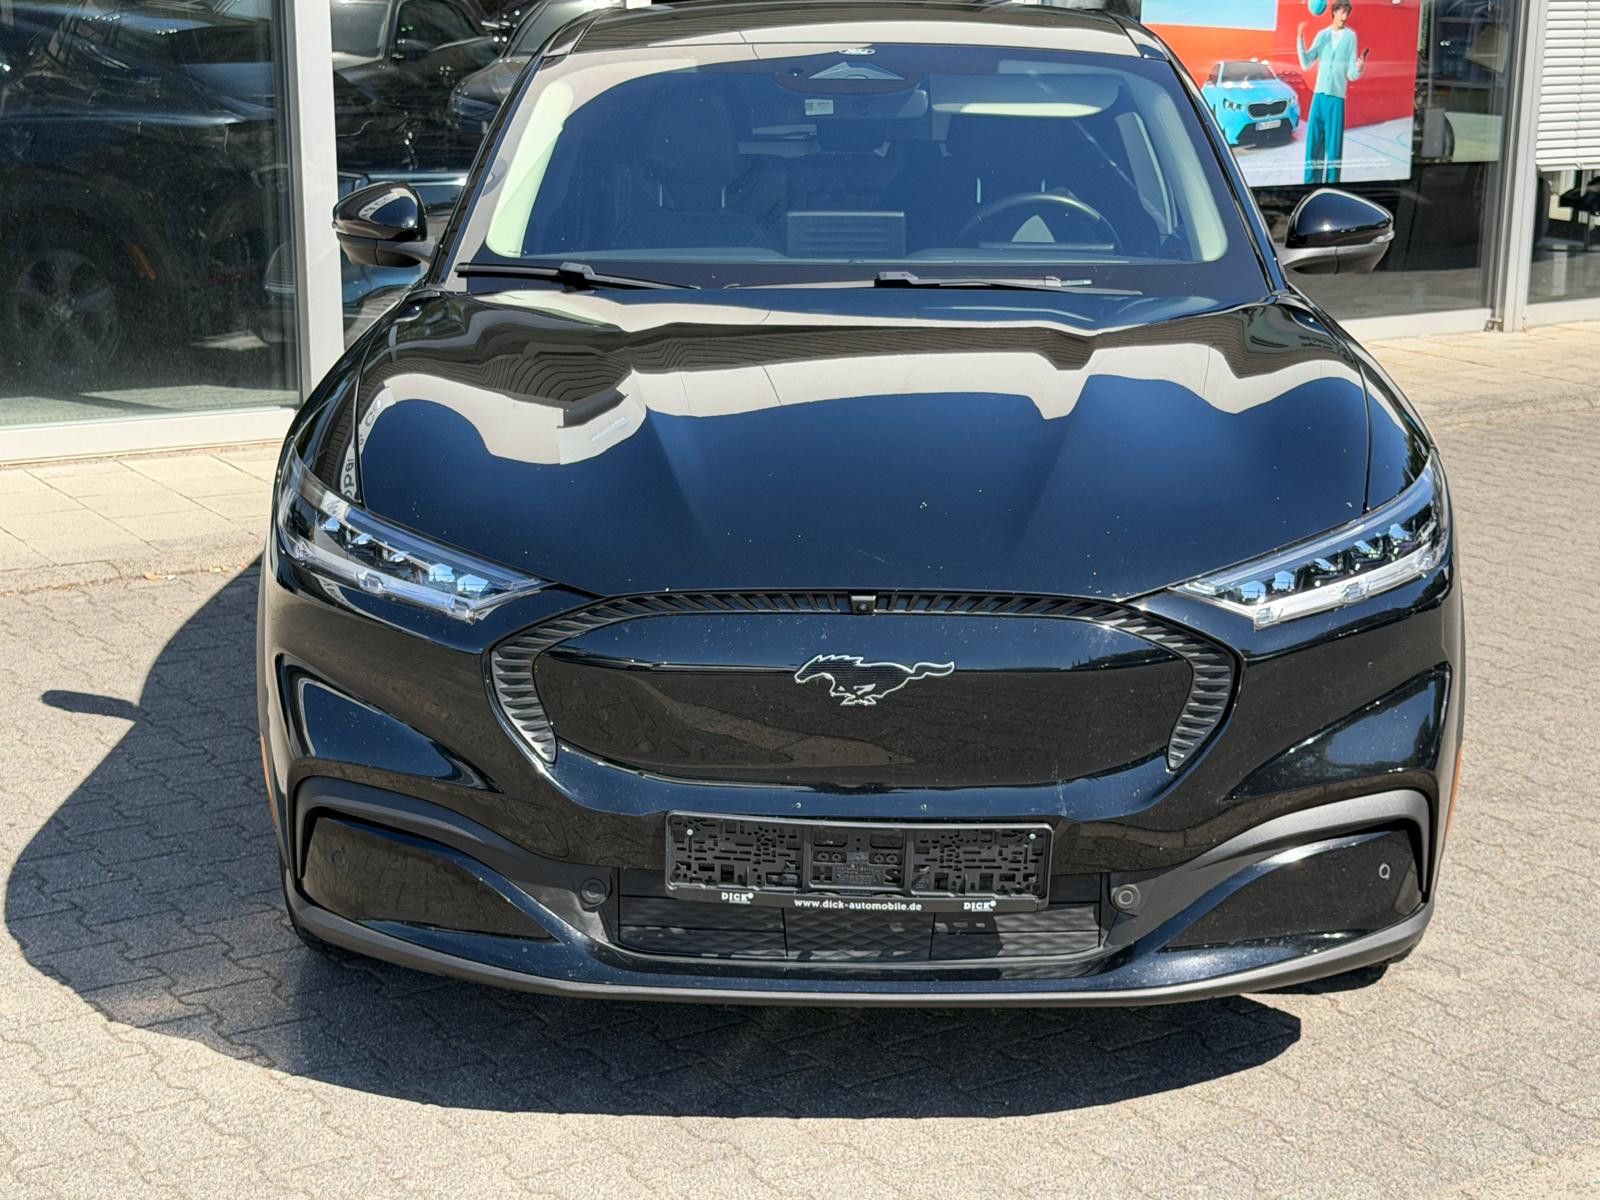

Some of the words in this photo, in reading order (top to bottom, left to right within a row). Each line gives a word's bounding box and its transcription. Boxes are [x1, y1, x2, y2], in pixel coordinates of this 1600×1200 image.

[721, 892, 750, 902] DICK
[793, 898, 923, 911] www.dick-automobile.de
[963, 902, 992, 911] DICK
